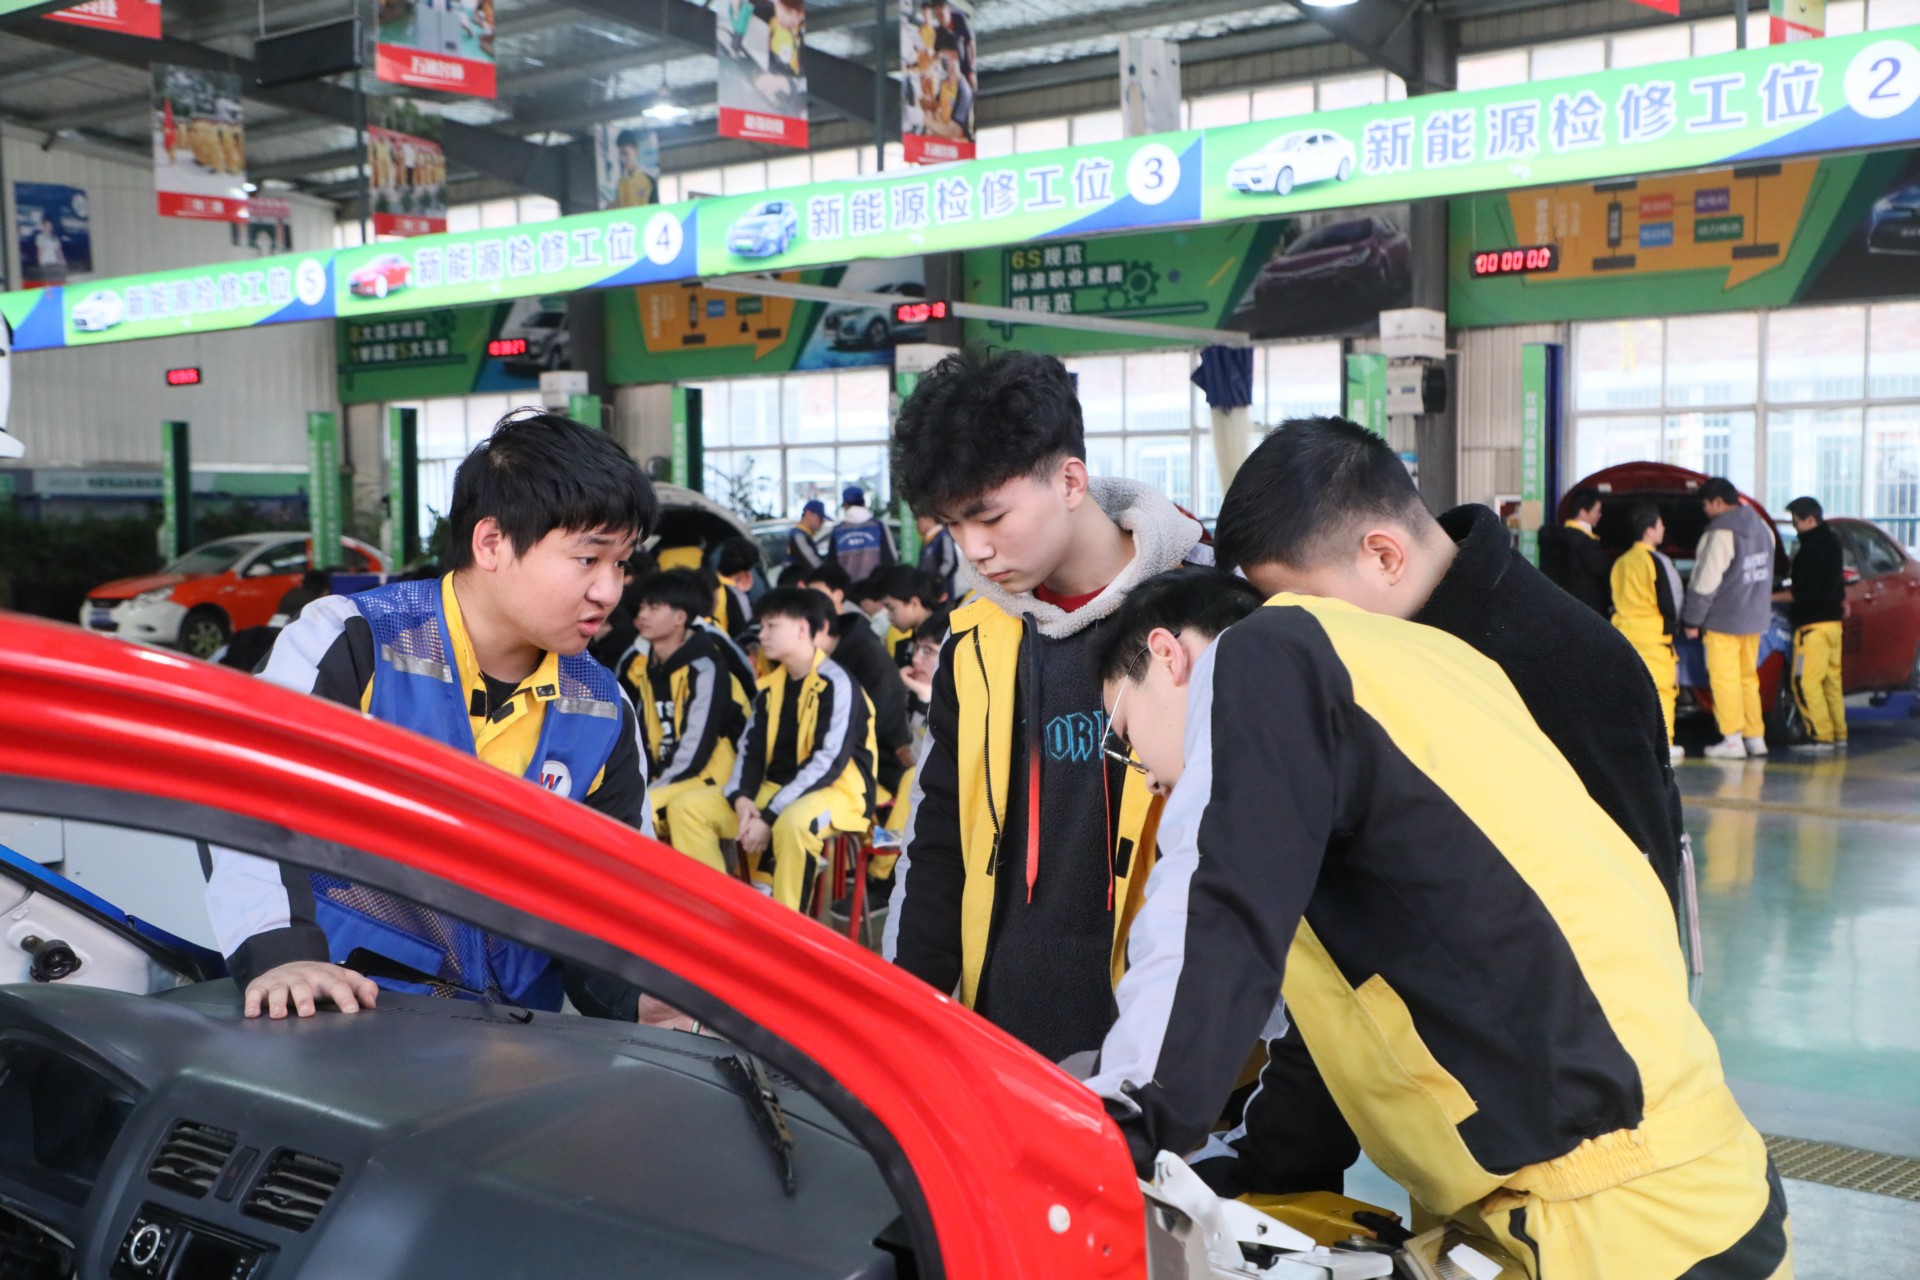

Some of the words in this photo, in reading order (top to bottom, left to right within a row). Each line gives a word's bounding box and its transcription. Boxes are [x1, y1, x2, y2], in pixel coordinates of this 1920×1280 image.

[1365, 62, 1822, 171] 新能源检修工位
[1868, 57, 1902, 101] 2
[810, 161, 1112, 237] 新能源检修工位
[1143, 157, 1164, 190] 3
[418, 224, 635, 283] 新能源检修工位
[656, 224, 671, 248] 4
[1011, 244, 1082, 270] 6S规范
[127, 270, 290, 318] 新能源检修工位
[304, 274, 317, 295] 5
